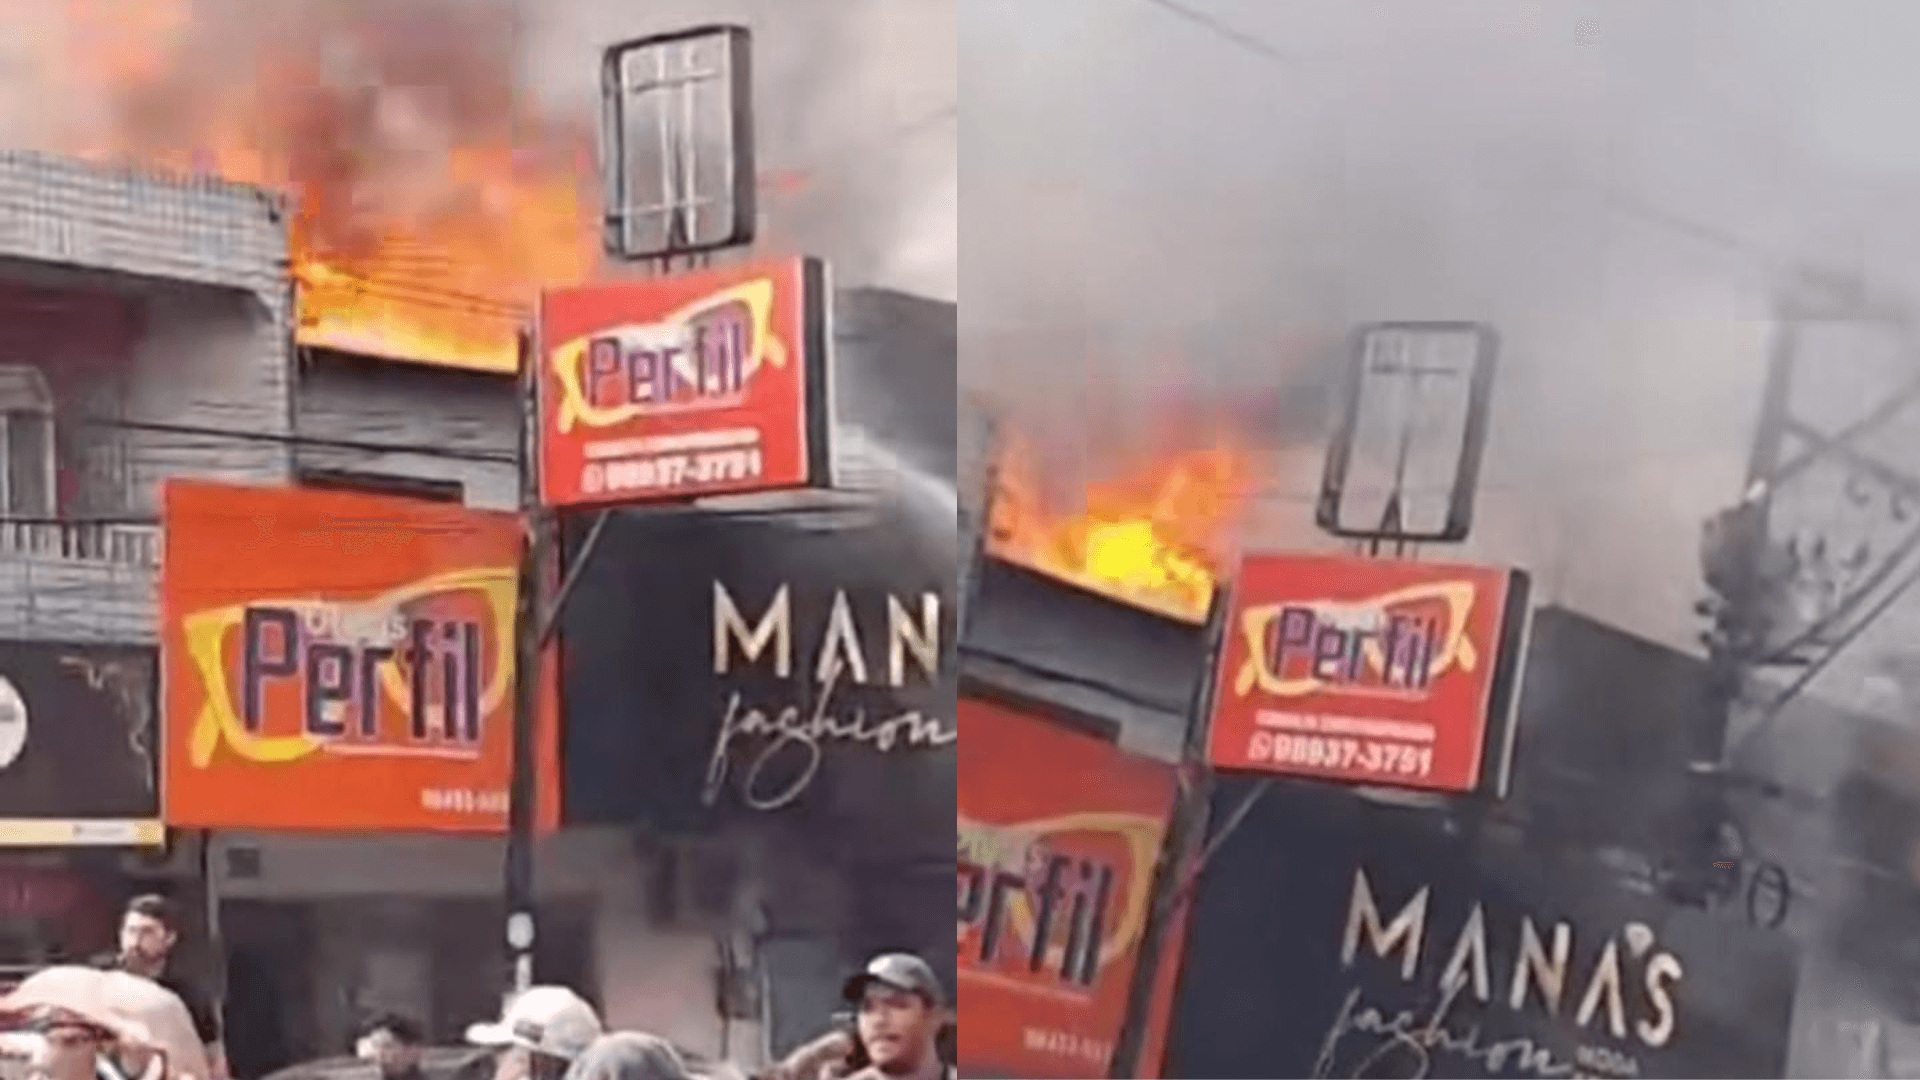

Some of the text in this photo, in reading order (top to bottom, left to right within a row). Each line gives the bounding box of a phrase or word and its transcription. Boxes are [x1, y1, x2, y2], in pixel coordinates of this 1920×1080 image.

[586, 318, 742, 407] Perfil
[242, 606, 481, 742] Perfil
[713, 577, 939, 688] MAN
[1271, 608, 1437, 688] Perfil
